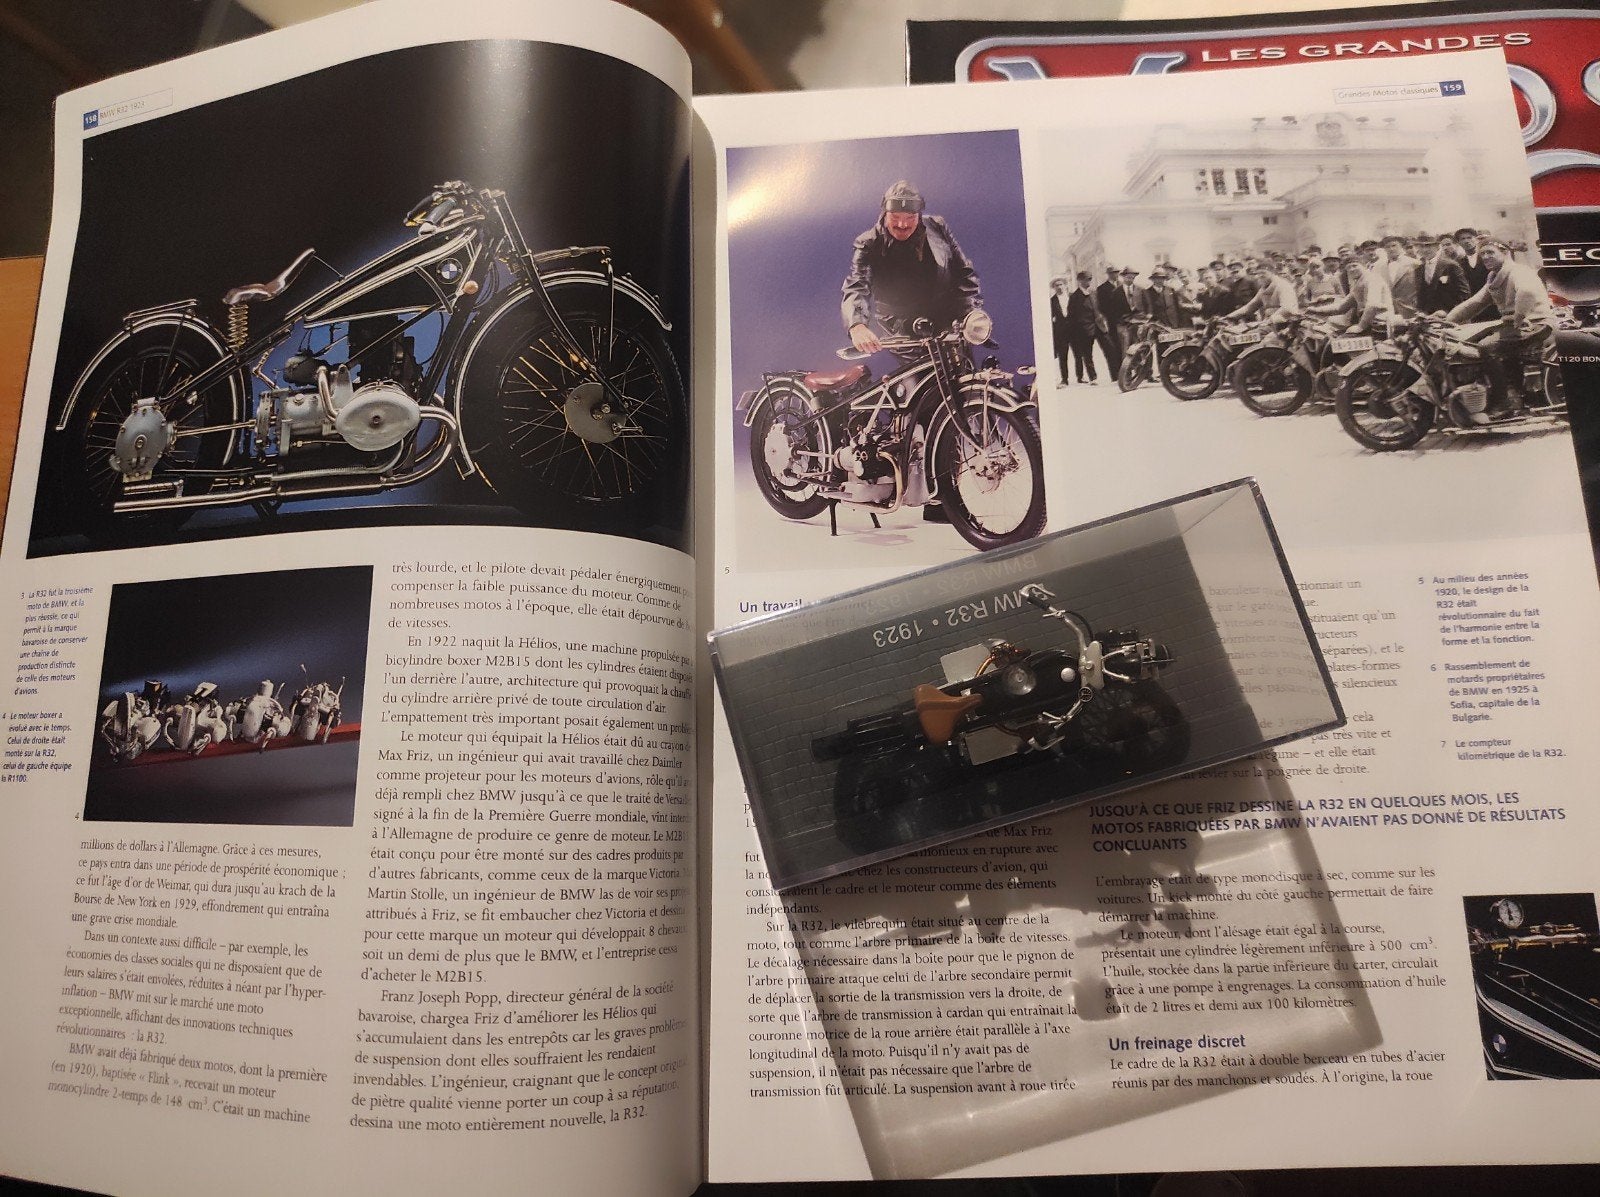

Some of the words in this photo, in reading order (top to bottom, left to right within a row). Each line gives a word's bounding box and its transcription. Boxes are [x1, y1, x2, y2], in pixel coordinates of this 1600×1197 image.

[1200, 48, 1286, 62] LES
[1299, 32, 1532, 57] GRANDES
[85, 114, 98, 124] 158
[1496, 572, 1528, 580] années
[1435, 588, 1460, 596] 1920,
[1473, 586, 1504, 595] design
[740, 602, 758, 613] Un
[945, 600, 988, 626] R32
[1438, 611, 1506, 620] révolutionnaire
[1453, 623, 1502, 632] l'harmonie
[873, 620, 923, 648] 1923
[1492, 634, 1534, 643] fonction.
[408, 636, 421, 646] En
[428, 636, 456, 646] 1922
[462, 636, 499, 650] naquit
[504, 636, 513, 647] la
[518, 636, 560, 650] Hélios,
[565, 642, 587, 651] une
[591, 642, 637, 655] machine
[640, 649, 679, 662] propulsée
[1444, 660, 1516, 670] Rassemblement
[1447, 674, 1484, 683] motards
[1486, 672, 1545, 684] propriétaires
[1448, 688, 1460, 696] de
[1450, 700, 1475, 708] Sofia,
[1478, 698, 1514, 709] capitale
[1516, 697, 1528, 706] de
[1530, 697, 1540, 705] la
[1452, 713, 1492, 723] Bulgarie.
[7, 736, 21, 744] Celui
[1468, 738, 1511, 748] compteur
[42, 749, 56, 757] R32,
[1458, 751, 1515, 760] kilométrique
[1544, 748, 1566, 756] R32.
[26, 761, 48, 771] gauche
[50, 762, 72, 771] équipe
[1089, 802, 1148, 817] JUSQU'À
[1154, 804, 1169, 815] CE
[1174, 802, 1203, 816] QUE
[1208, 802, 1236, 813] FRIZ
[1240, 800, 1293, 812] DESSINE
[1298, 799, 1314, 811] LA
[1320, 798, 1344, 810] R32
[1348, 797, 1366, 809] EN
[1370, 794, 1446, 810] QUELQUES
[1450, 793, 1492, 806] MOIS,
[1496, 792, 1519, 803] LES
[75, 811, 80, 820] 4
[1092, 822, 1143, 834] MOTOS
[1148, 817, 1230, 833] FABRIQUÉES
[1234, 820, 1260, 830] PAR
[1265, 818, 1300, 830] BMW
[1306, 814, 1378, 827] N'AVAIENT
[1383, 814, 1408, 825] PAS
[1412, 809, 1463, 825] DONNÉ
[1468, 811, 1486, 823] DE
[1490, 807, 1565, 821] RÉSULTATS
[1093, 838, 1187, 852] CONCLUANTS
[74, 892, 101, 904] Bourse
[104, 893, 114, 905] de
[117, 894, 137, 905] New
[139, 896, 156, 907] York
[159, 900, 170, 908] en
[174, 898, 198, 911] 1929,
[201, 898, 263, 914] effondrement
[266, 904, 283, 918] qui
[287, 904, 329, 917] entraîna
[746, 903, 821, 917] indépendants.
[1098, 911, 1149, 922] démarrer
[1153, 910, 1163, 920] la
[1168, 908, 1218, 920] machine.
[381, 990, 414, 1002] Franz
[418, 990, 460, 1007] Joseph
[465, 991, 501, 1007] Popp,
[506, 990, 564, 1002] directeur
[568, 986, 611, 1005] général
[616, 985, 628, 998] de
[633, 984, 641, 996] la
[644, 982, 672, 995] société
[59, 1006, 122, 1020] exceptionnelle,
[125, 1008, 162, 1023] affichant
[165, 1013, 180, 1025] des
[183, 1016, 235, 1032] innovations
[238, 1021, 293, 1040] techniques
[1109, 1038, 1128, 1050] Un
[1134, 1036, 1192, 1052] freinage
[1198, 1034, 1245, 1048] discret
[750, 1068, 814, 1081] suspension,
[819, 1065, 825, 1076] il
[830, 1065, 864, 1076] n'était
[870, 1068, 887, 1079] pas
[891, 1064, 947, 1075] nécessaire
[952, 1066, 972, 1077] que
[976, 1061, 1013, 1073] l'arbre
[1018, 1060, 1031, 1072] de
